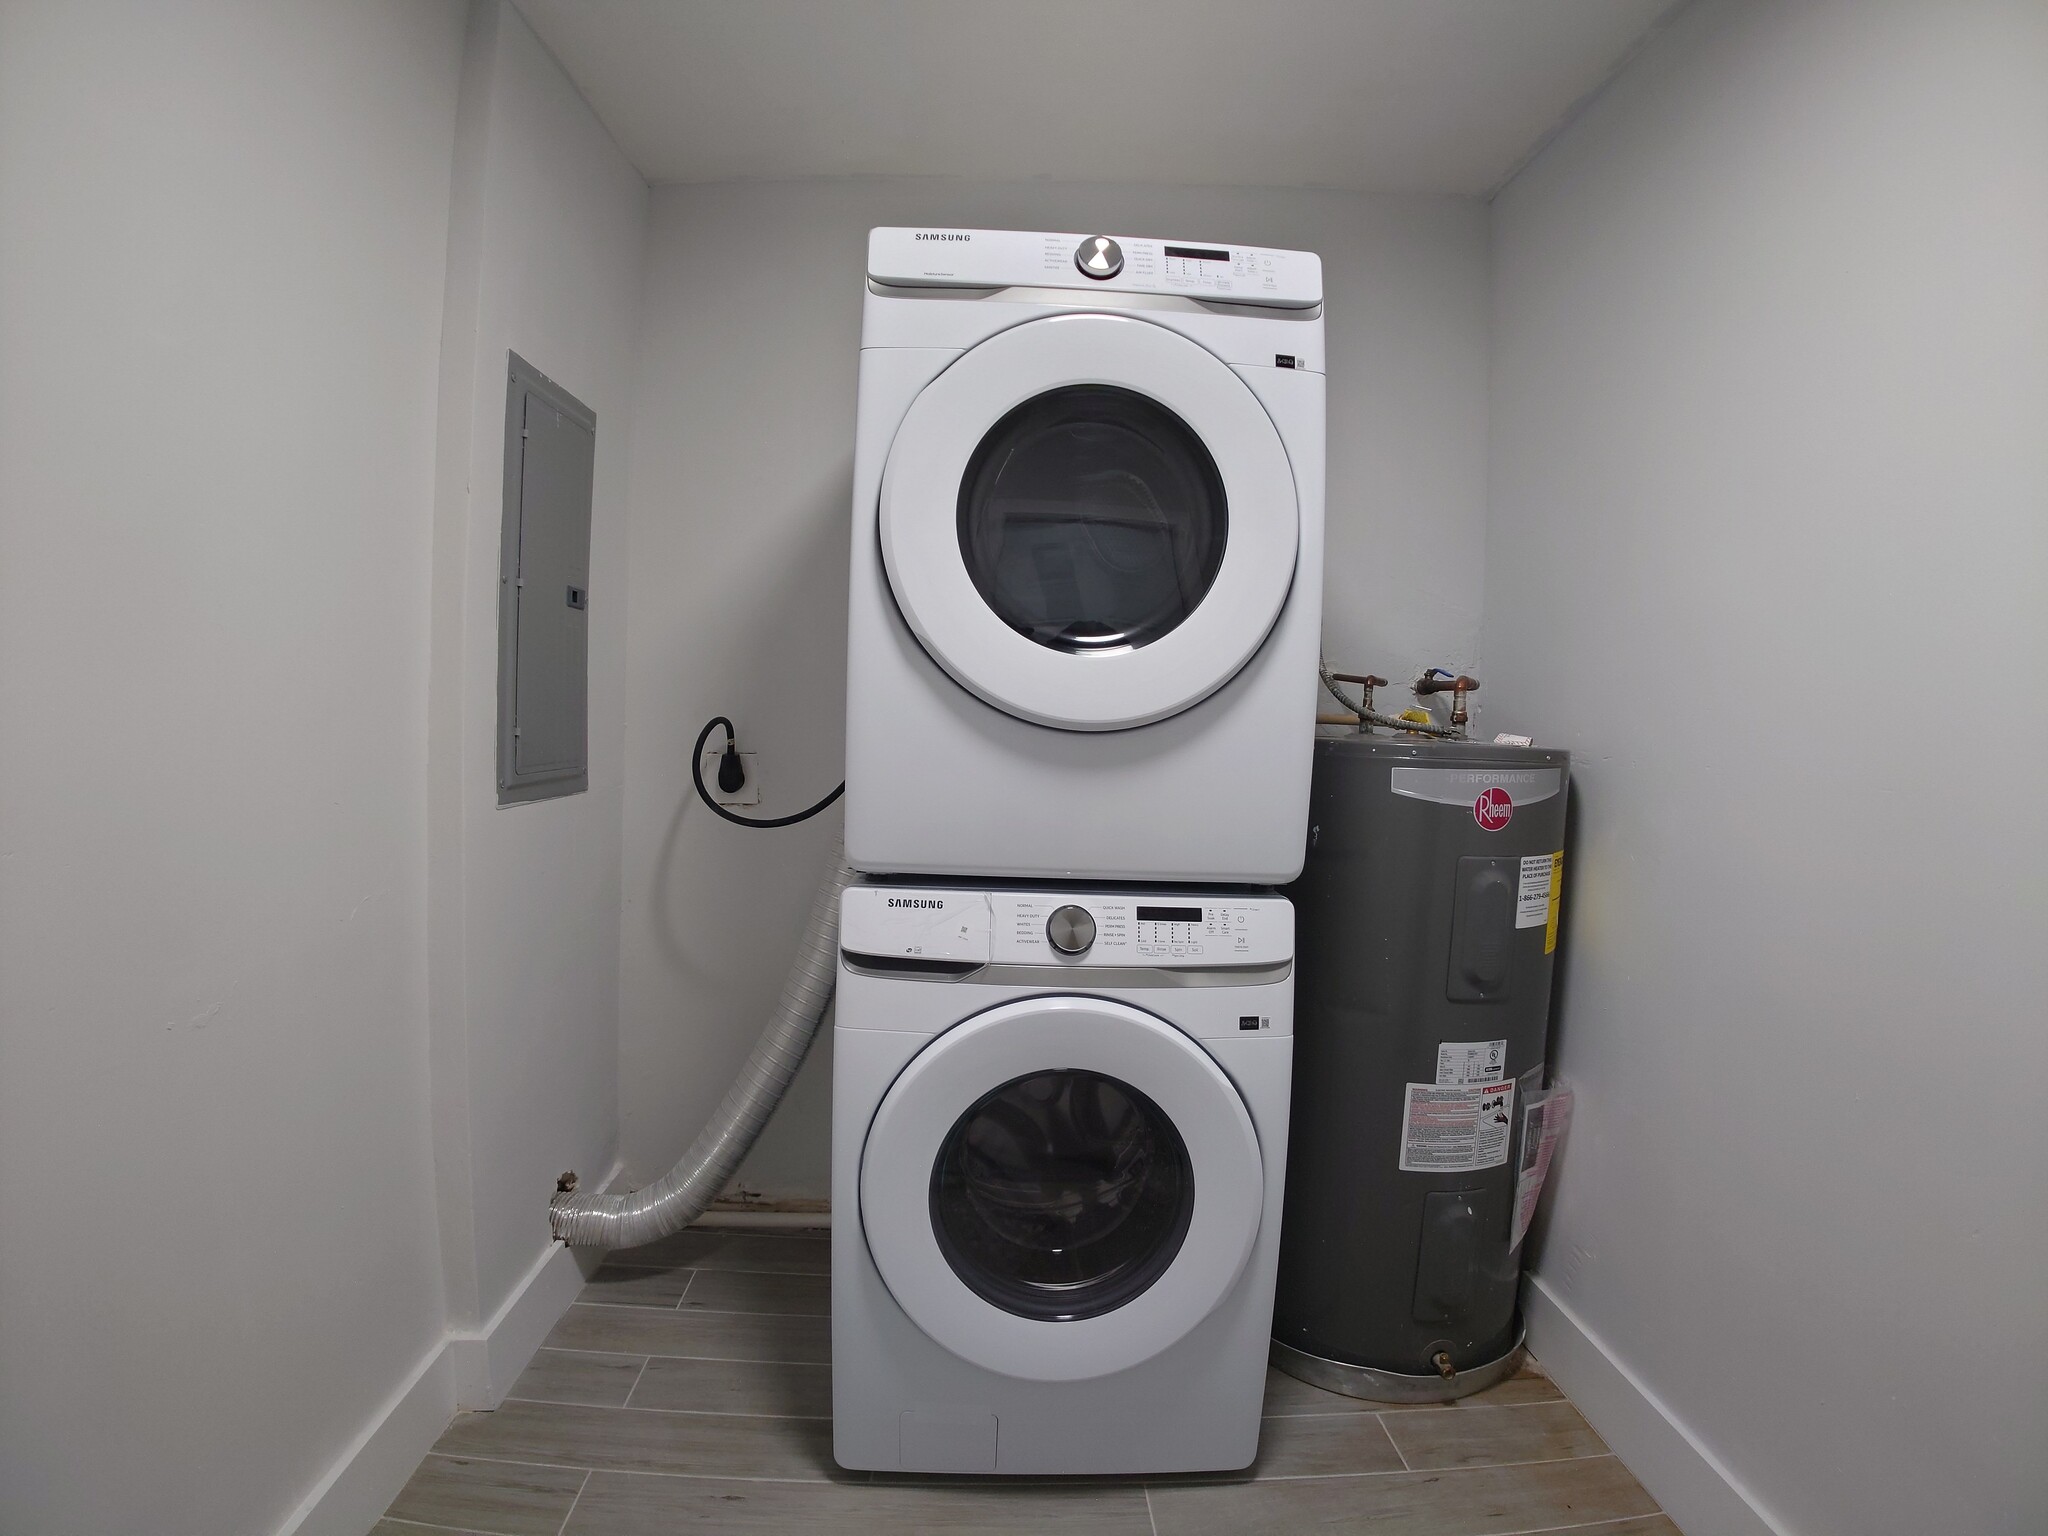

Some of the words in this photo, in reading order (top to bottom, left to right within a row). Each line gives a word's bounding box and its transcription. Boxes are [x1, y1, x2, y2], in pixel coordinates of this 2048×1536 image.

[915, 233, 971, 242] SAMSUNG
[1451, 773, 1536, 784] PERFORMANCE
[1479, 788, 1511, 823] Rheem
[888, 898, 944, 909] SAMSUNG
